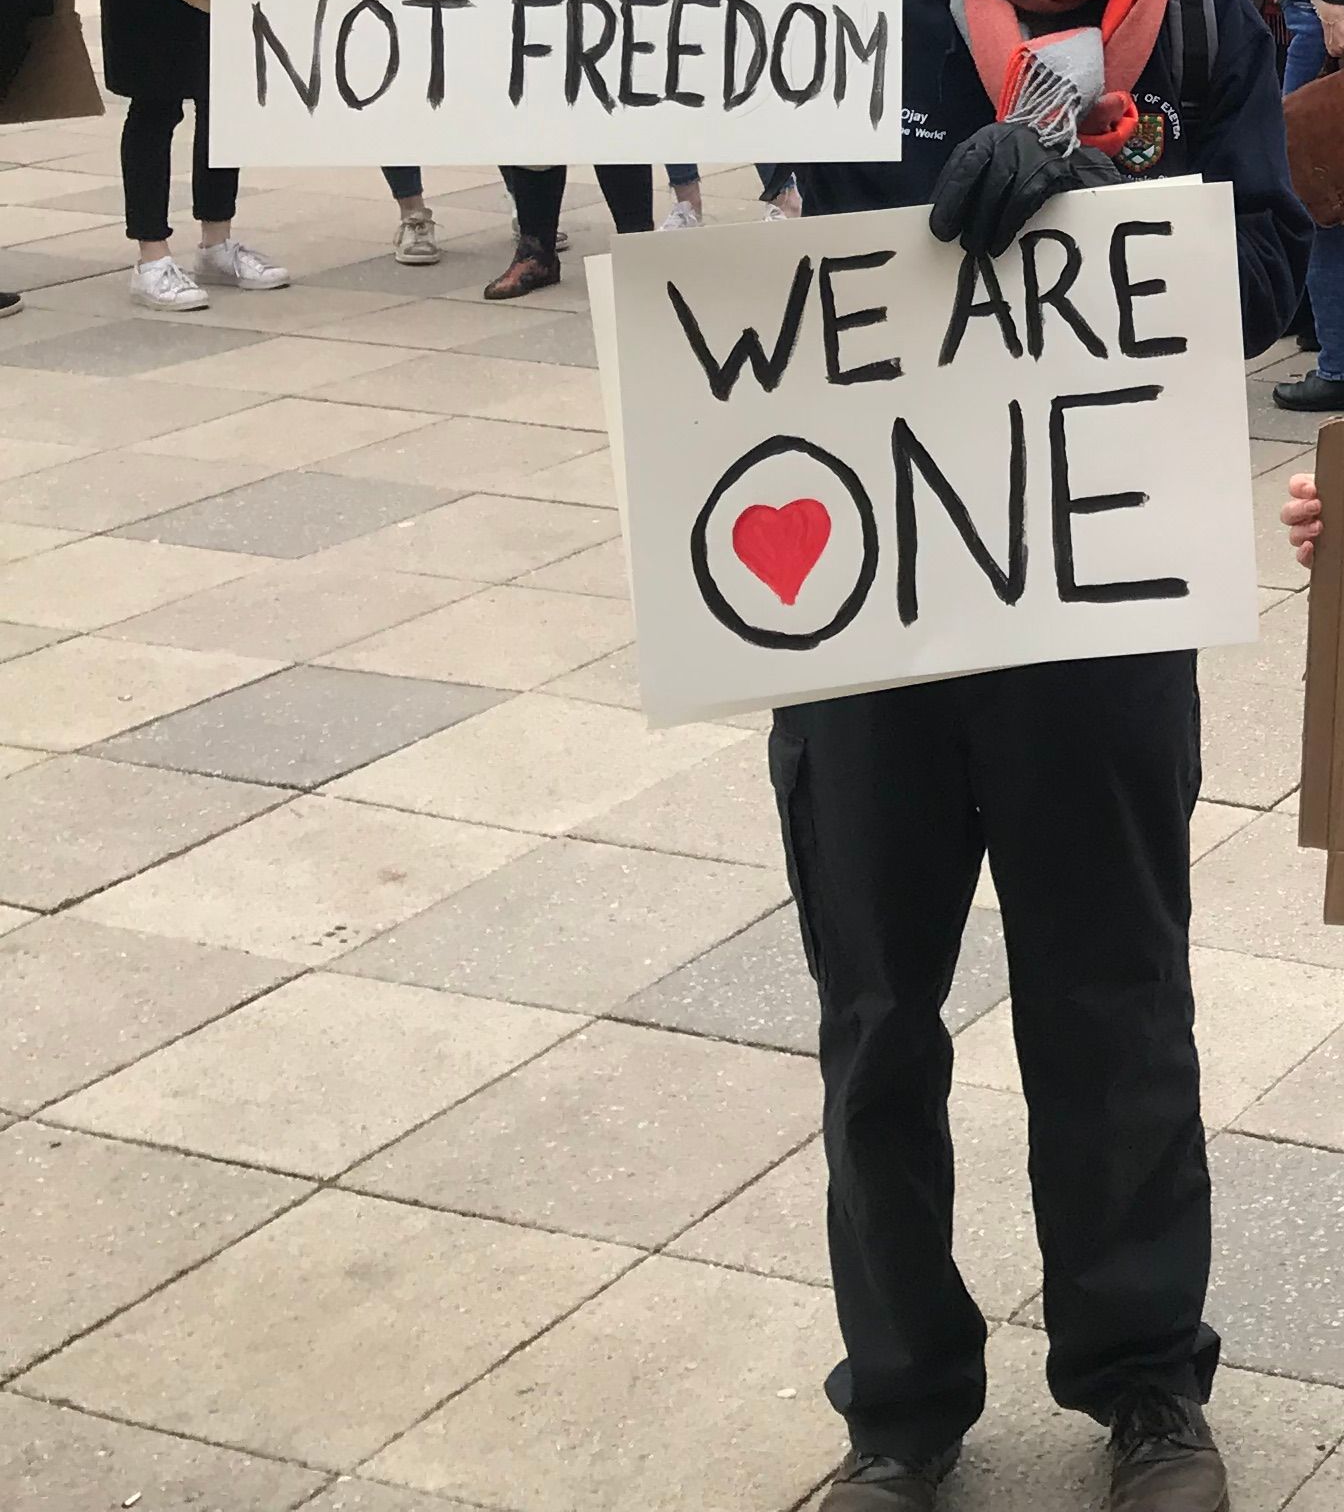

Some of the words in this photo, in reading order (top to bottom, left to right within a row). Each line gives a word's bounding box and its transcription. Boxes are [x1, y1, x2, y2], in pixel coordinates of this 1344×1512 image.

[1144, 93, 1161, 104] OF
[1161, 101, 1181, 140] EXETER
[667, 249, 905, 402] WE
[937, 220, 1188, 367] ARE
[690, 384, 1190, 650] ONE
